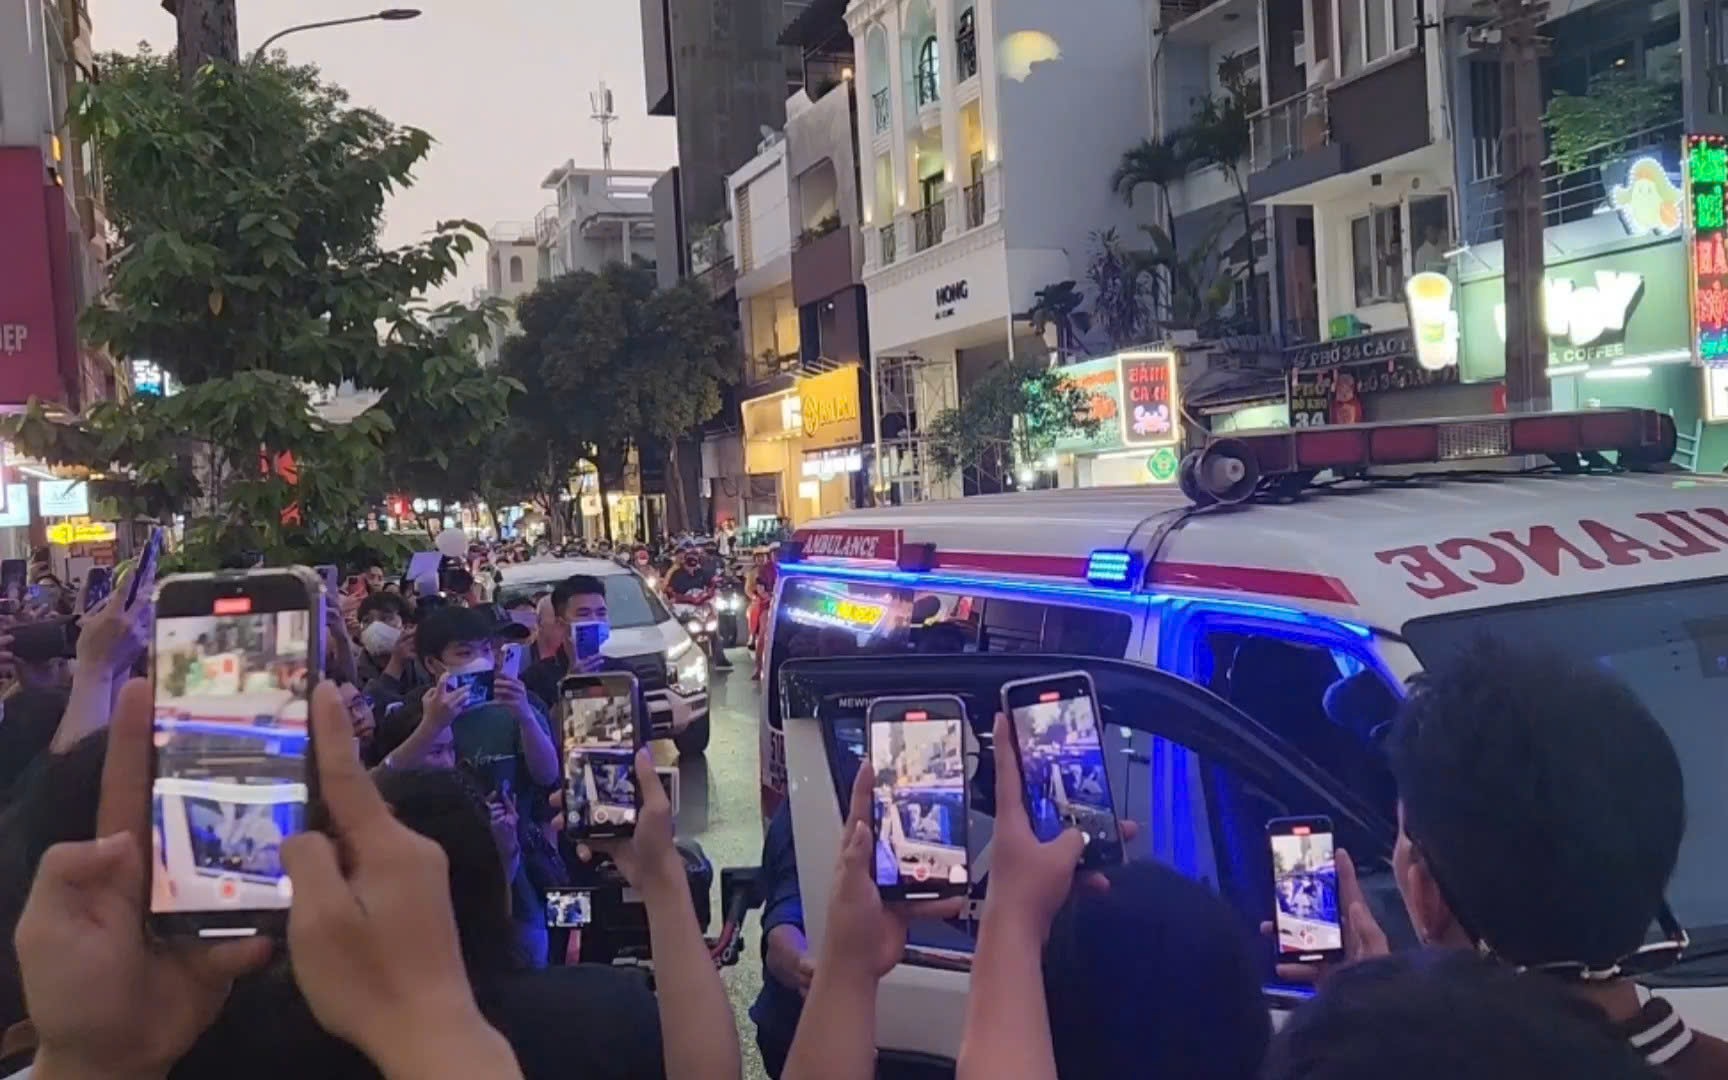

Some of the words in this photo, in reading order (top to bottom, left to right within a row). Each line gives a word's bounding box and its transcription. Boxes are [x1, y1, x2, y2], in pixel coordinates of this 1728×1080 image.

[0, 324, 28, 356] ẸP
[1563, 342, 1625, 362] COFFEE
[1295, 411, 1325, 428] 34
[801, 533, 880, 558] AMBULANCE
